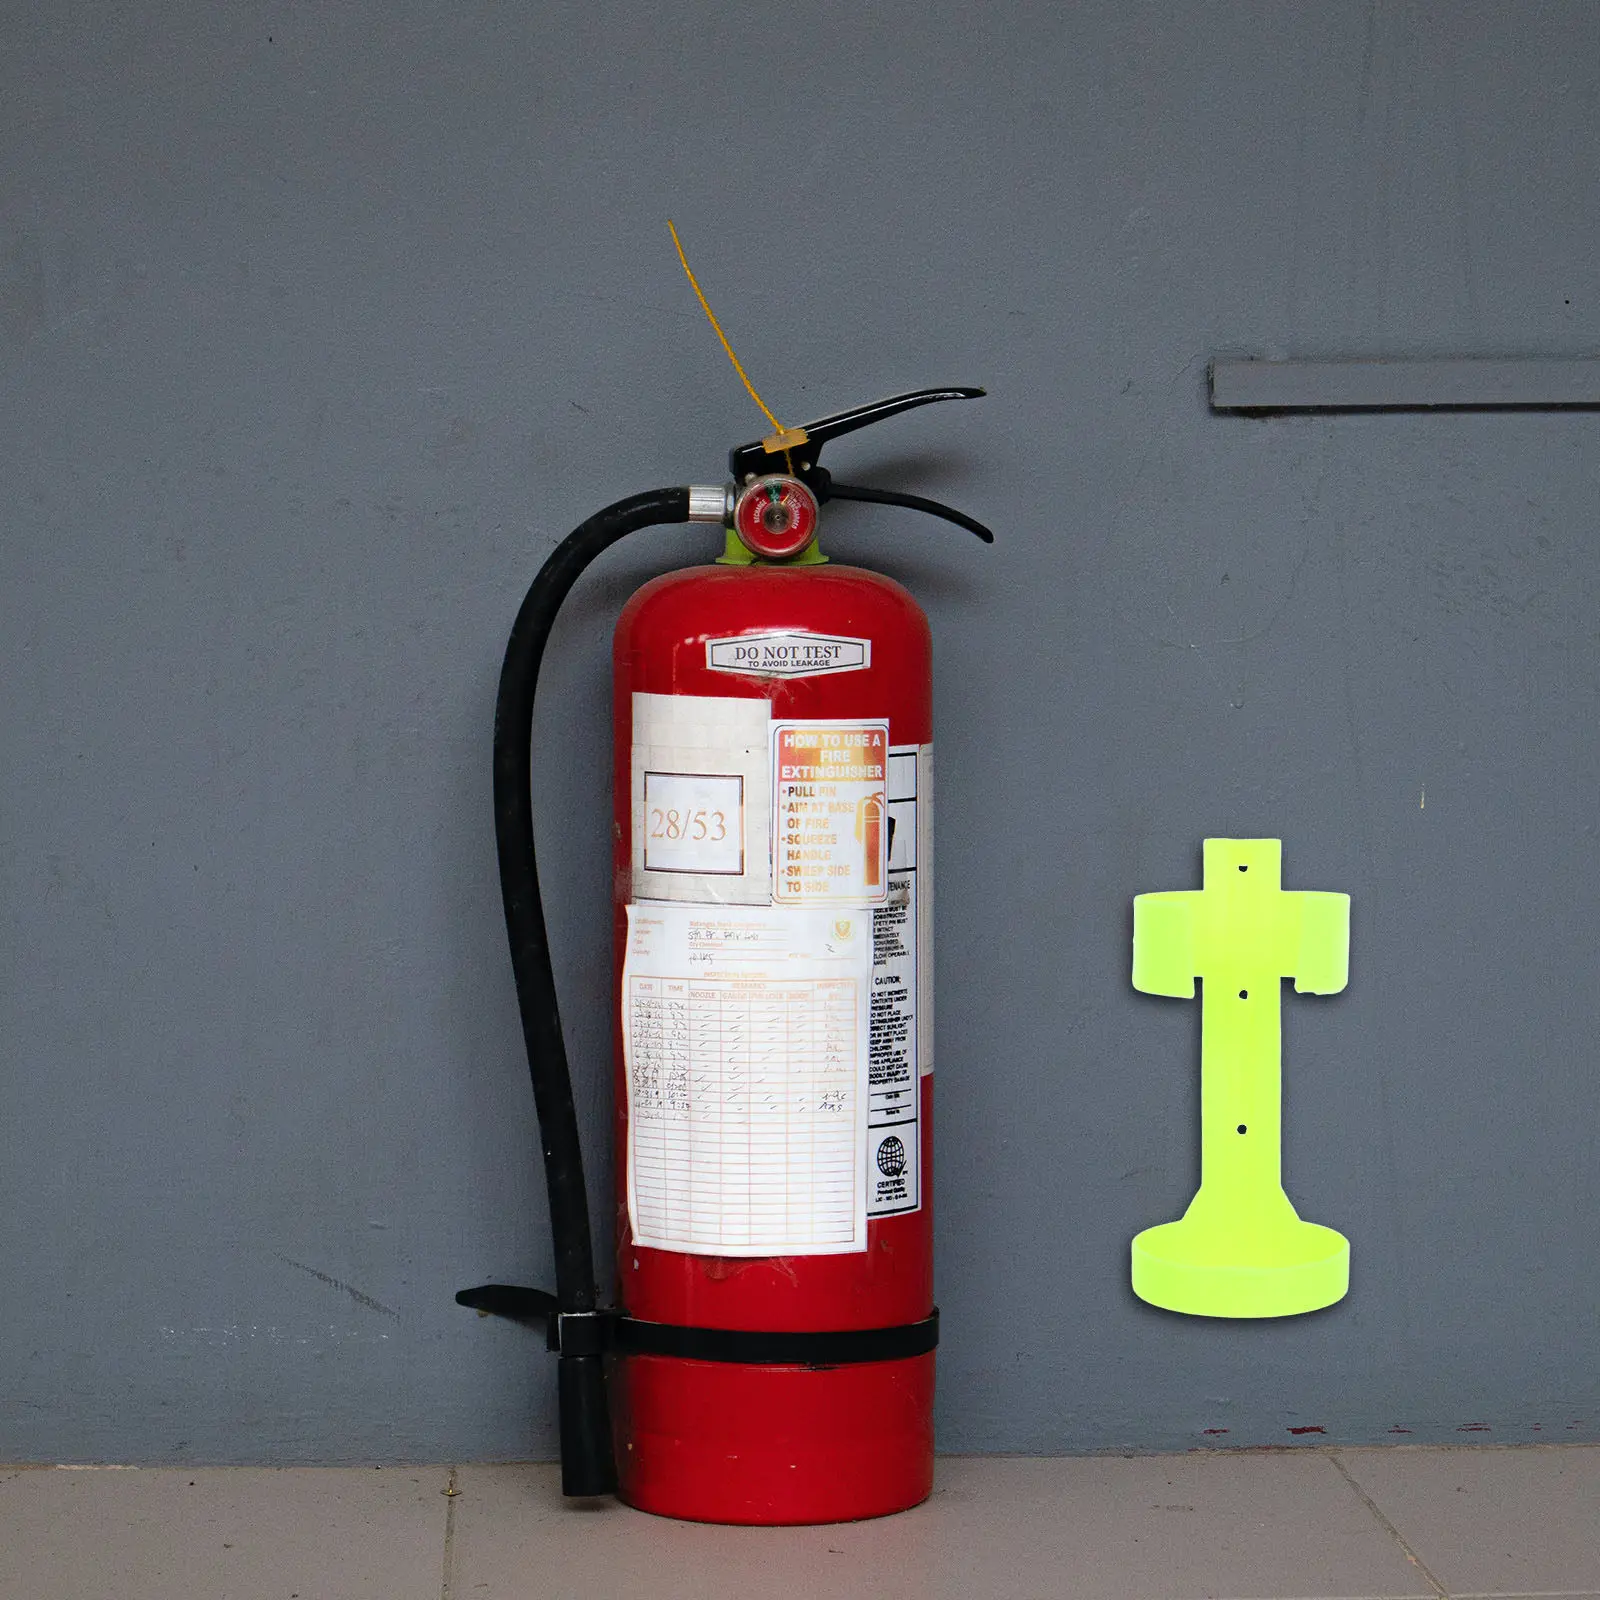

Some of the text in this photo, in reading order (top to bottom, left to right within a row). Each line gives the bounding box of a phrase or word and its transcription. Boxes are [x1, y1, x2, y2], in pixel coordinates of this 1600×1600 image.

[735, 645, 841, 660] DO NOT TEST
[784, 734, 880, 747] HOW TO USE A
[820, 750, 851, 763] FIRE
[781, 765, 882, 778] EXTINGUISHER
[788, 786, 836, 797] PULL PIN
[787, 802, 854, 813] AIM AT BASE
[651, 808, 726, 840] 28/53
[787, 818, 829, 829] OF FIRE
[787, 834, 837, 845] SQUEEZE
[787, 850, 831, 860] HANDLE
[787, 865, 851, 877] SWEEP SIDE
[787, 881, 829, 892] TO SIDE
[877, 1179, 905, 1188] CERTIFIED
